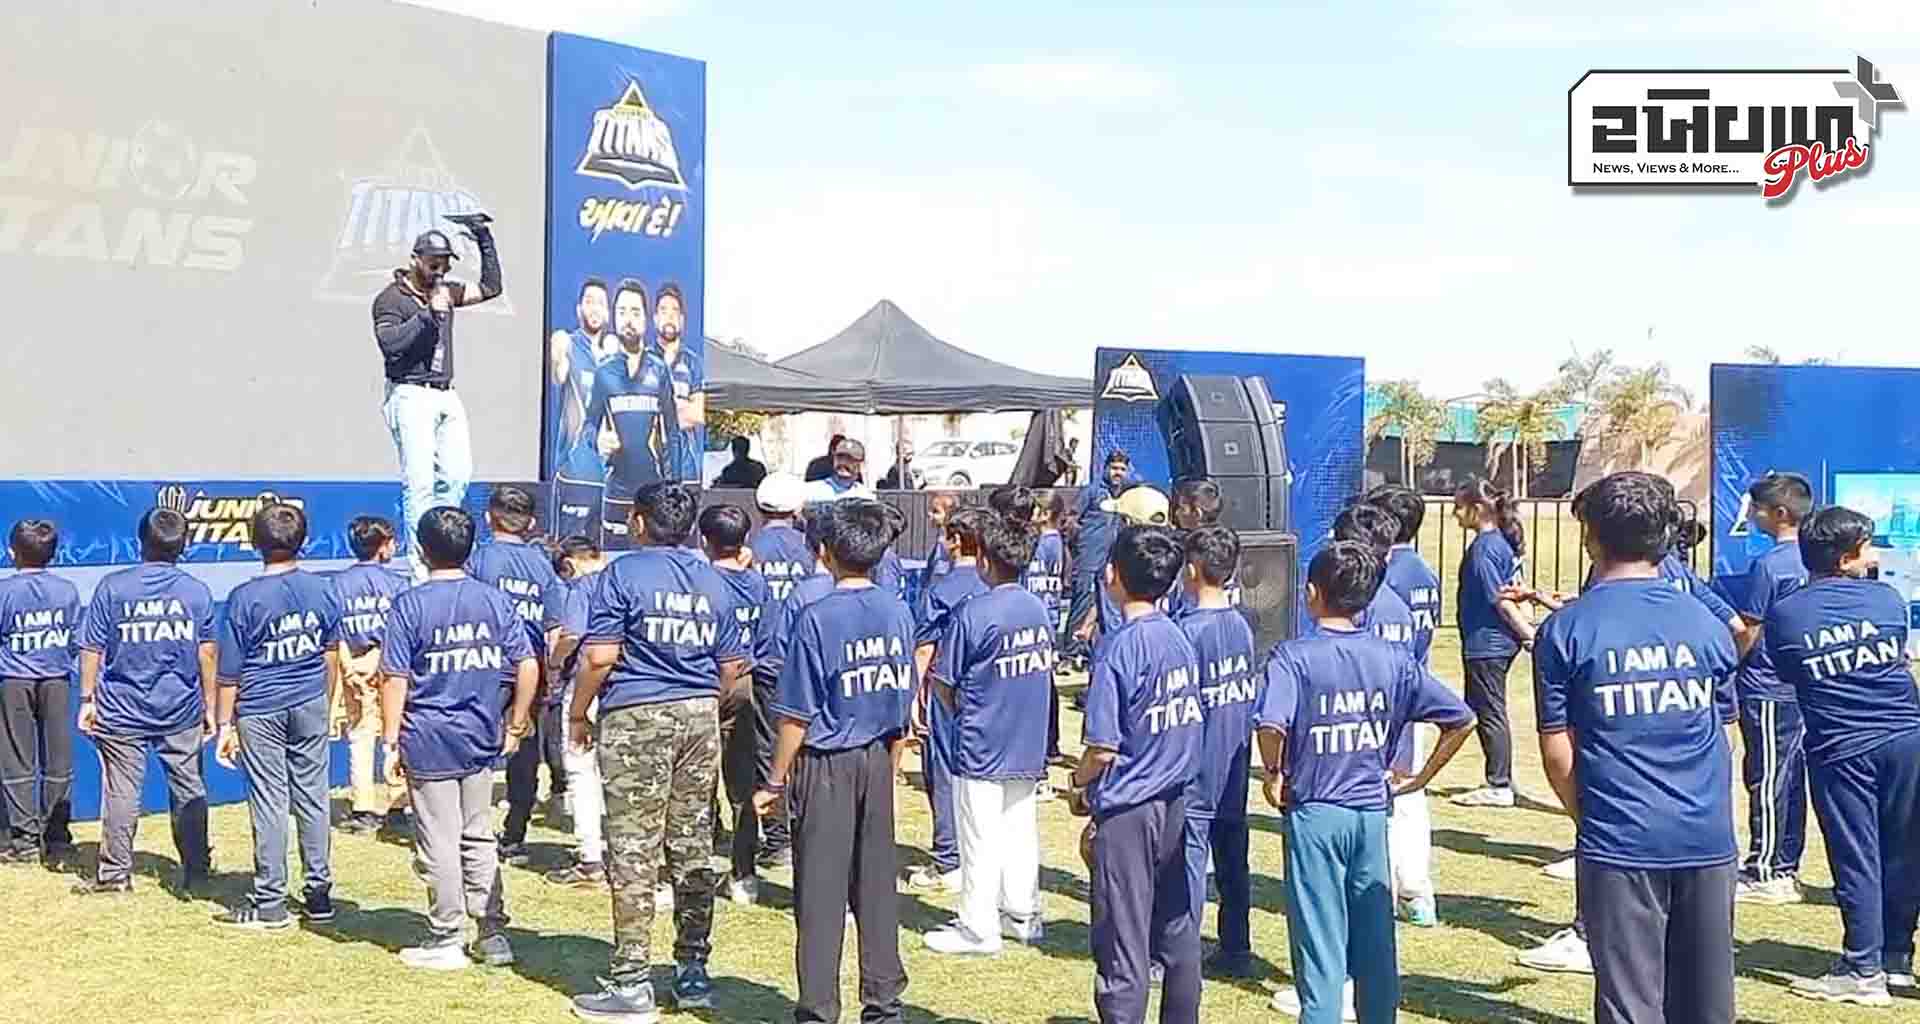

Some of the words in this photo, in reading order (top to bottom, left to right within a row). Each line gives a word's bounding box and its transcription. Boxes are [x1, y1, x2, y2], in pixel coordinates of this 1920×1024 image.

[791, 561, 804, 576] A
[528, 583, 540, 597] A
[124, 602, 131, 617] I
[133, 600, 164, 617] AM
[168, 599, 184, 616] A
[655, 592, 661, 611] I
[664, 594, 693, 614] AM
[695, 595, 711, 614] A
[15, 612, 21, 627] I
[23, 610, 51, 627] AM
[269, 621, 277, 636] I
[278, 612, 303, 634] AM
[304, 611, 320, 628] A
[117, 620, 195, 643] TITAN
[435, 628, 441, 645] I
[445, 623, 474, 644] AM
[475, 622, 491, 639] A
[643, 617, 717, 647] TITAN
[1003, 635, 1009, 650] I
[1011, 629, 1035, 649] AM
[1037, 626, 1049, 642] A
[1803, 631, 1813, 650] I
[1818, 623, 1857, 649] AM
[1859, 619, 1881, 642] A
[424, 646, 501, 673] TITAN
[846, 643, 853, 662] I
[855, 637, 886, 658] AM
[889, 636, 903, 656] A
[1607, 649, 1617, 675] I
[1624, 644, 1668, 673] AM
[1675, 644, 1697, 670] A
[1802, 637, 1902, 682] TITAN
[1235, 654, 1248, 673] A
[841, 663, 911, 697] TITAN
[1320, 695, 1326, 716] I
[1334, 691, 1366, 715] AM
[1369, 691, 1386, 712] A
[1595, 677, 1713, 718] TITAN
[1146, 695, 1204, 735] TITA
